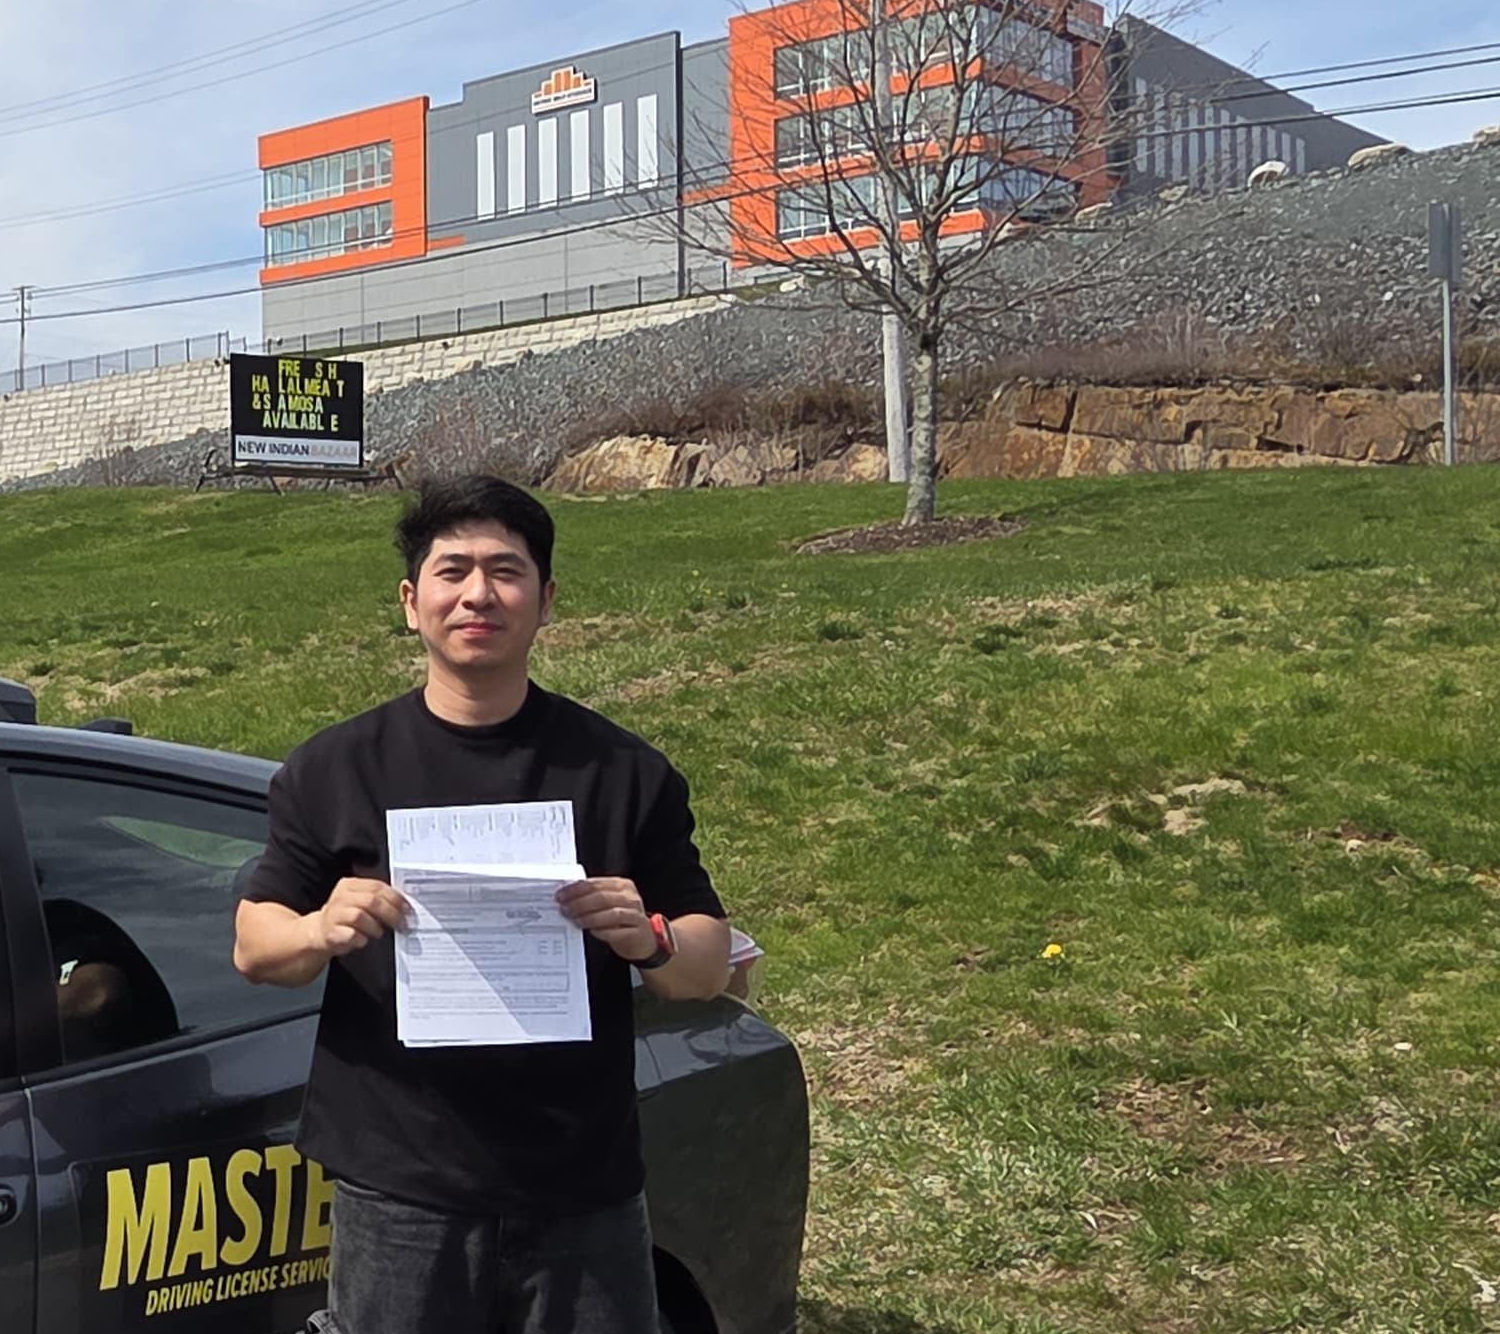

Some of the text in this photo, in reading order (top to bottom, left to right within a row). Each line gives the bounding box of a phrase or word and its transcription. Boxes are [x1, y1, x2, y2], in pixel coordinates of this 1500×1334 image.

[238, 440, 266, 454] NEW
[269, 442, 309, 456] INDIAN
[145, 1278, 214, 1316] DRIVING
[216, 1266, 279, 1302] LICENSE
